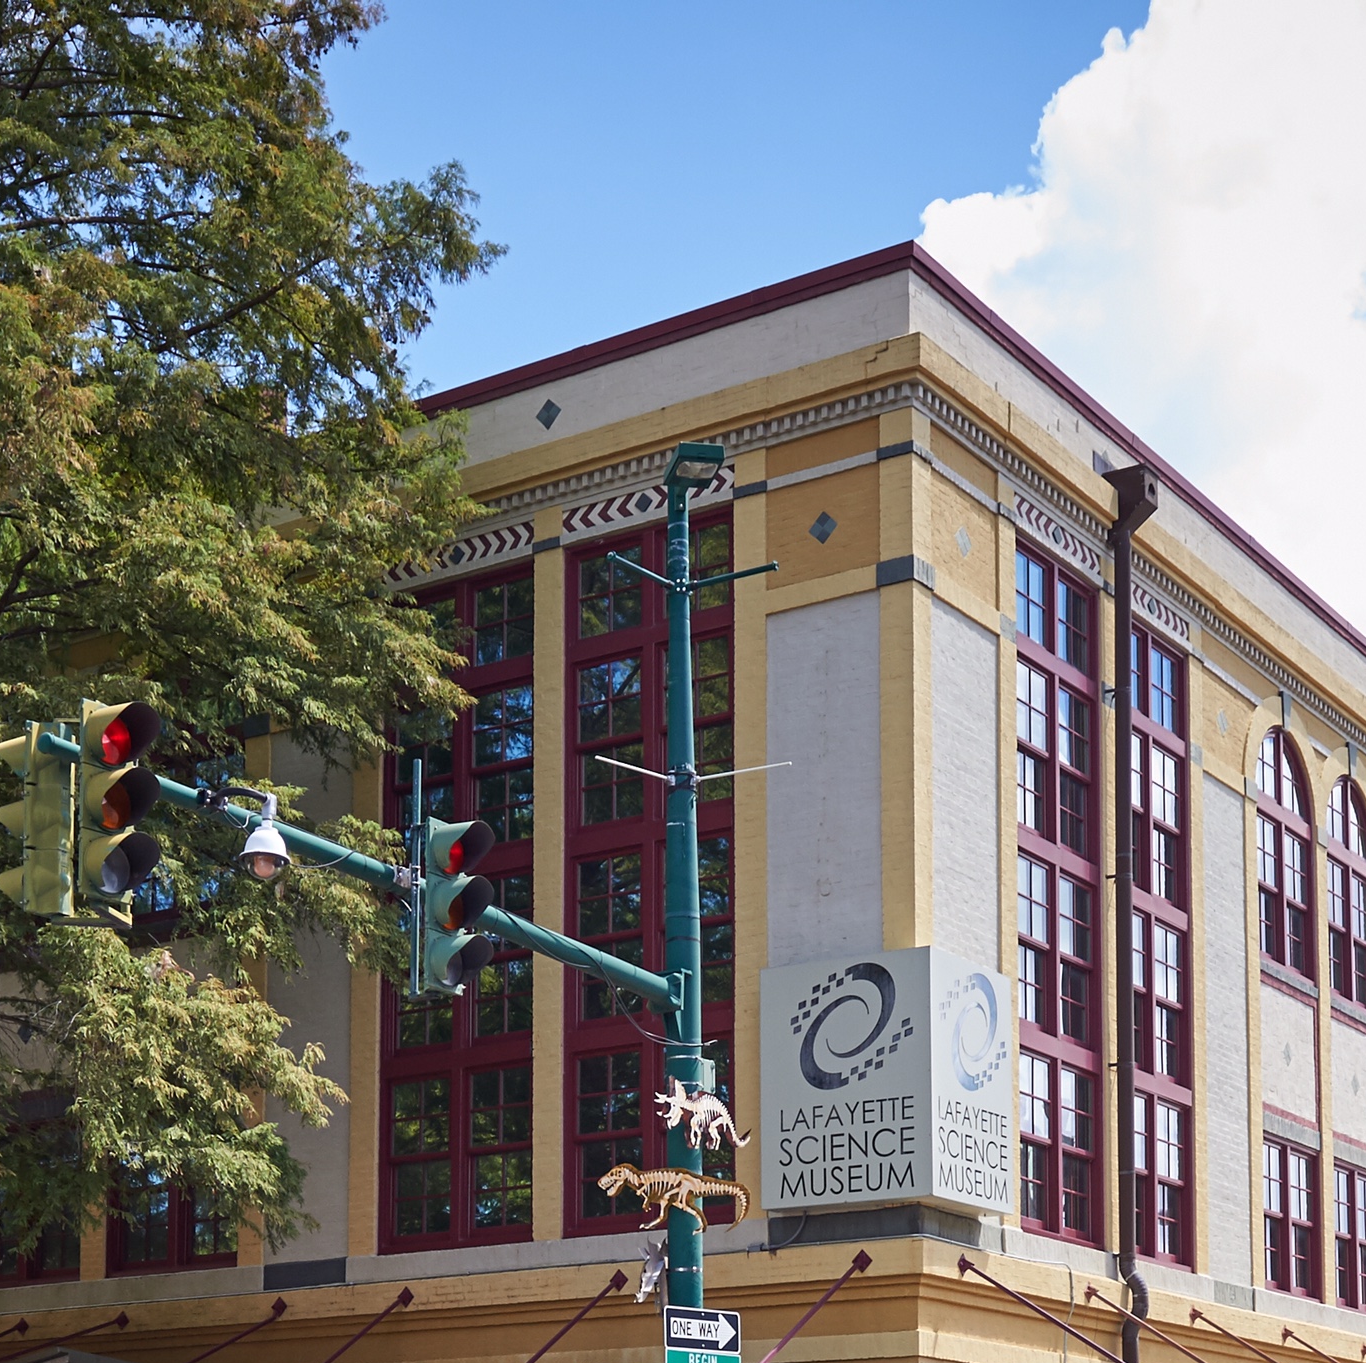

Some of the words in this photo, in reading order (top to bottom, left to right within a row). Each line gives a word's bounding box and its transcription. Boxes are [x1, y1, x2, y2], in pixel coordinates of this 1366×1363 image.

[780, 1096, 915, 1132] LAFAYETTE
[938, 1095, 1008, 1139] LAFAYETTE
[779, 1126, 915, 1167] SCIENCE
[938, 1126, 1008, 1172] SCIENCE
[780, 1161, 915, 1199] MUSEUM
[938, 1161, 1009, 1204] MUSEUM
[671, 1320, 693, 1336] ONE
[699, 1322, 720, 1338] WAY
